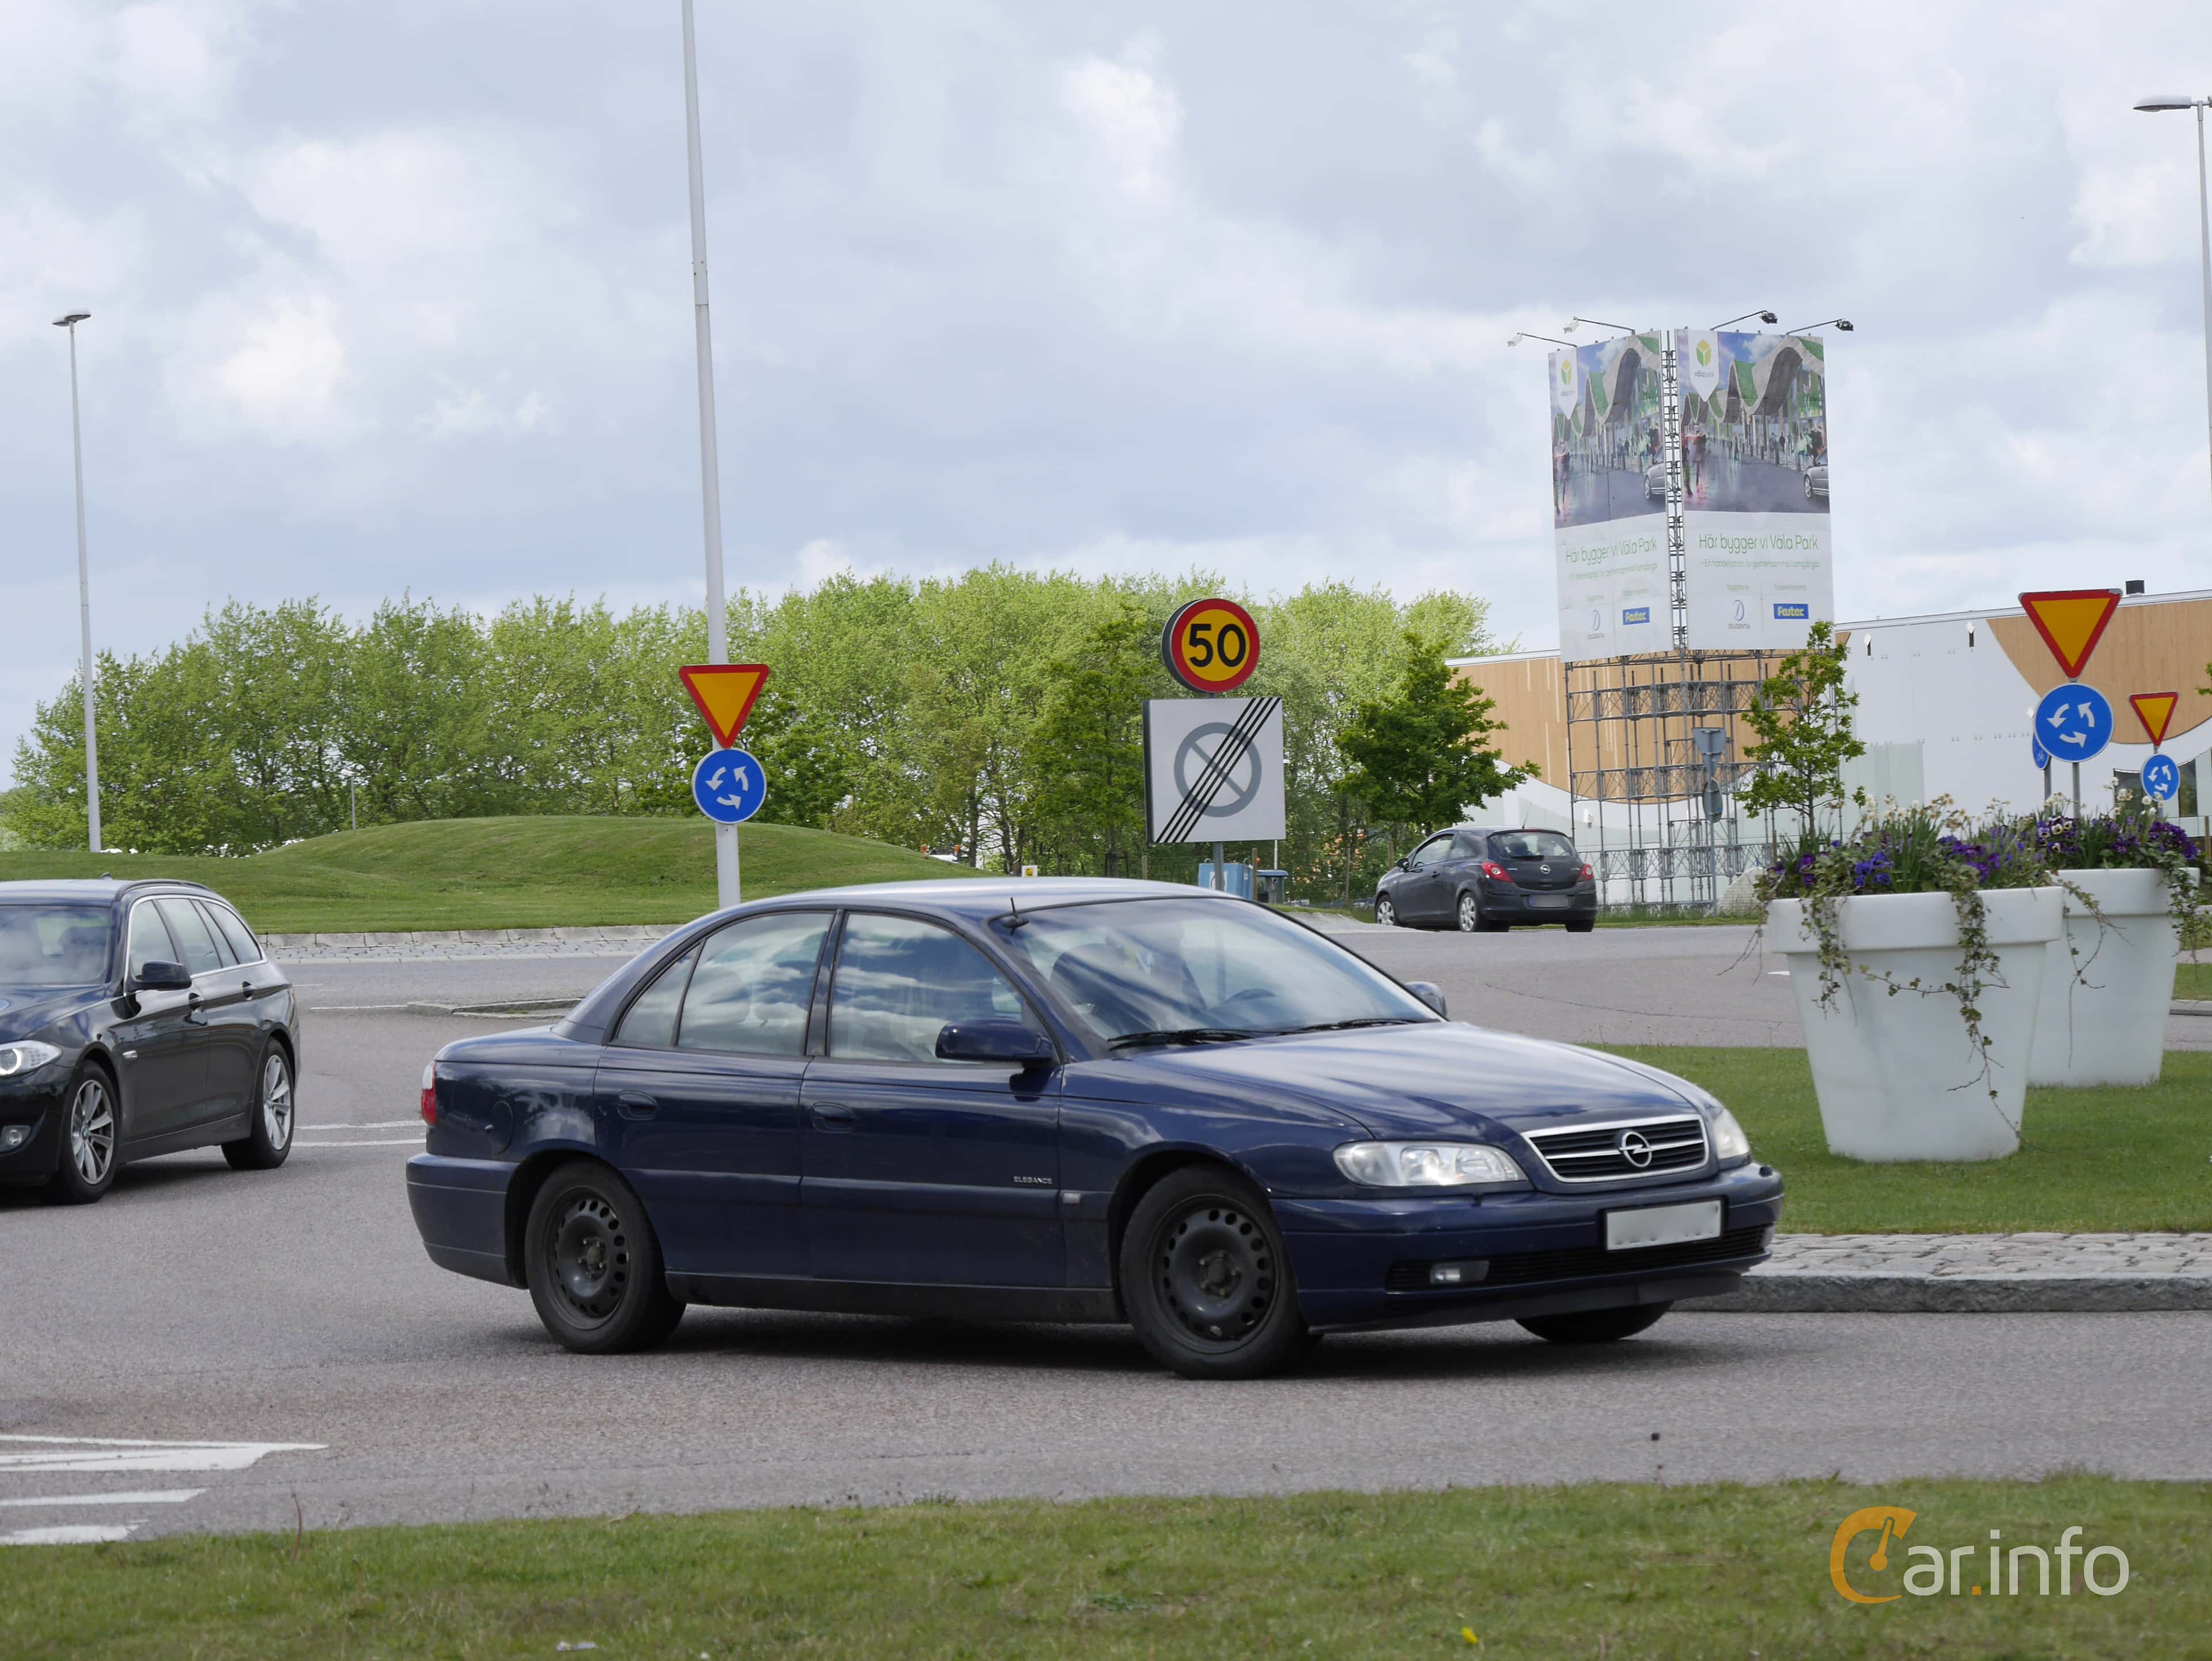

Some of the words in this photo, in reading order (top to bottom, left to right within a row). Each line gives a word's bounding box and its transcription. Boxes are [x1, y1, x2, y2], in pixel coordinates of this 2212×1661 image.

[1581, 546, 1609, 565] bygger
[1611, 544, 1618, 557] vi
[1639, 535, 1657, 553] Park
[1699, 534, 1718, 548] Här
[1720, 533, 1758, 554] bygger
[1760, 534, 1768, 549] vi
[1770, 534, 1793, 550] Väla
[1795, 534, 1819, 550] Park
[1778, 606, 1804, 617] Fastec
[1189, 623, 1247, 668] 50
[1013, 1176, 1053, 1185] ELEGANCE
